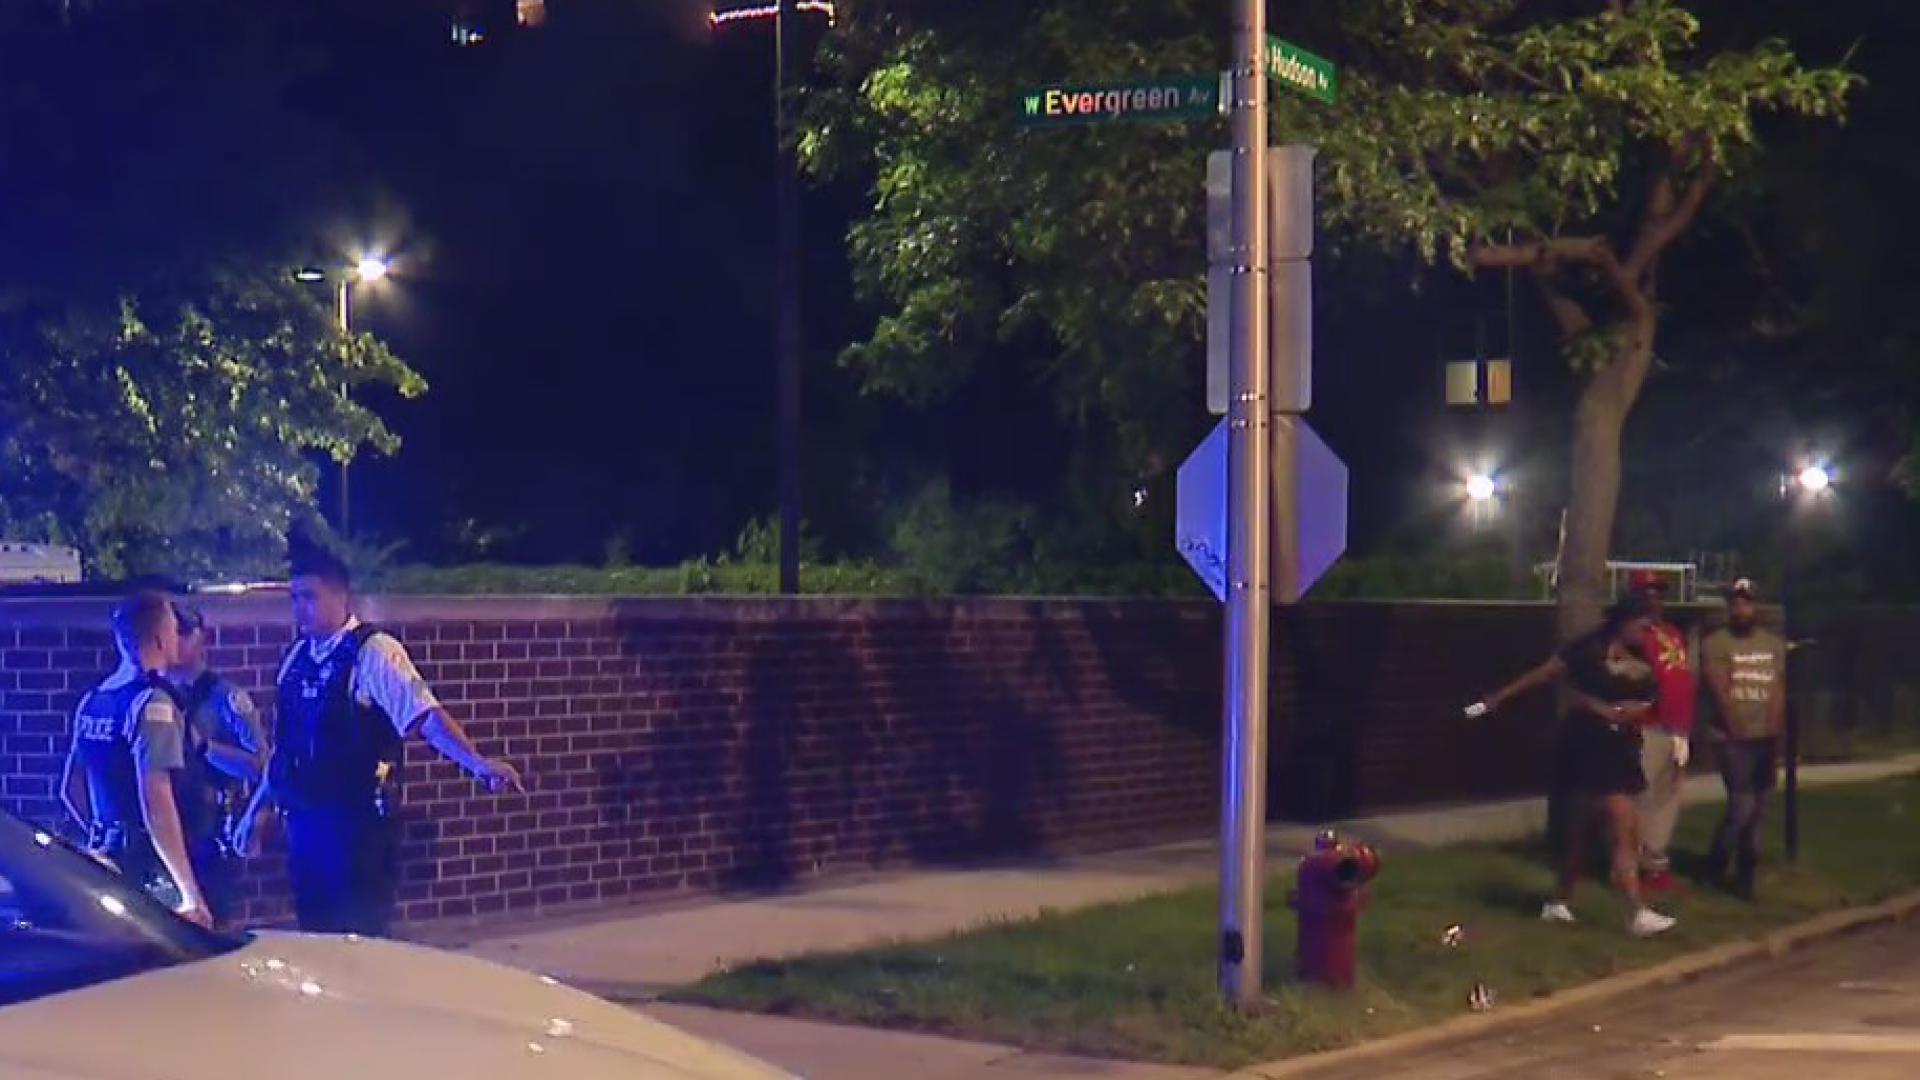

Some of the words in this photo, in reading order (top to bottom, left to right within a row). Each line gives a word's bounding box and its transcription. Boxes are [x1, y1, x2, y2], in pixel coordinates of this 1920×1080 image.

[1271, 45, 1317, 89] Hudson
[1025, 96, 1040, 115] W
[1046, 86, 1180, 116] Evergreen
[1189, 87, 1211, 104] Av
